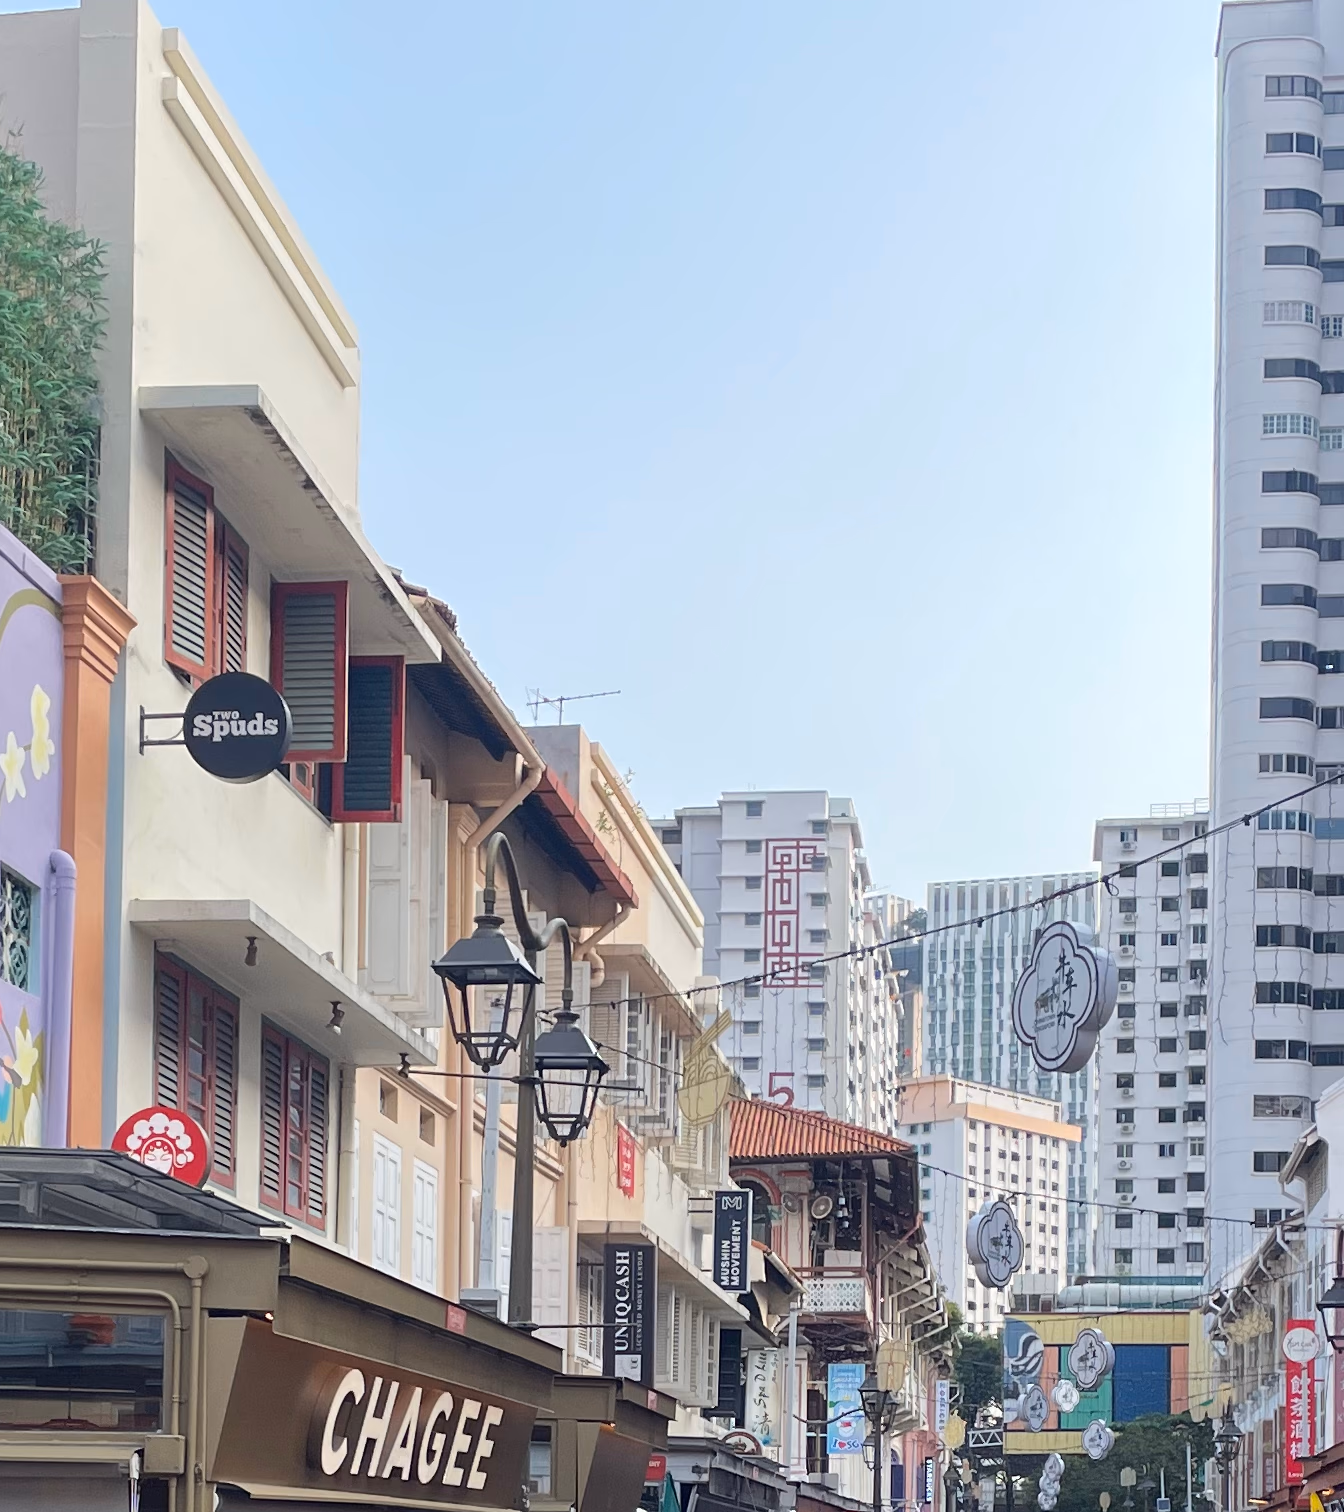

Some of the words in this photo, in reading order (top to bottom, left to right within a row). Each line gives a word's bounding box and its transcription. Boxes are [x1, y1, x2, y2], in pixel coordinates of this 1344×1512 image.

[192, 712, 279, 742] Spuds
[212, 711, 240, 720] TWO
[721, 1240, 730, 1286] MUSHIN
[731, 1220, 741, 1286] MOVEMENT
[615, 1250, 632, 1352] UNIQCASH
[321, 1368, 504, 1490] CHAGEE
